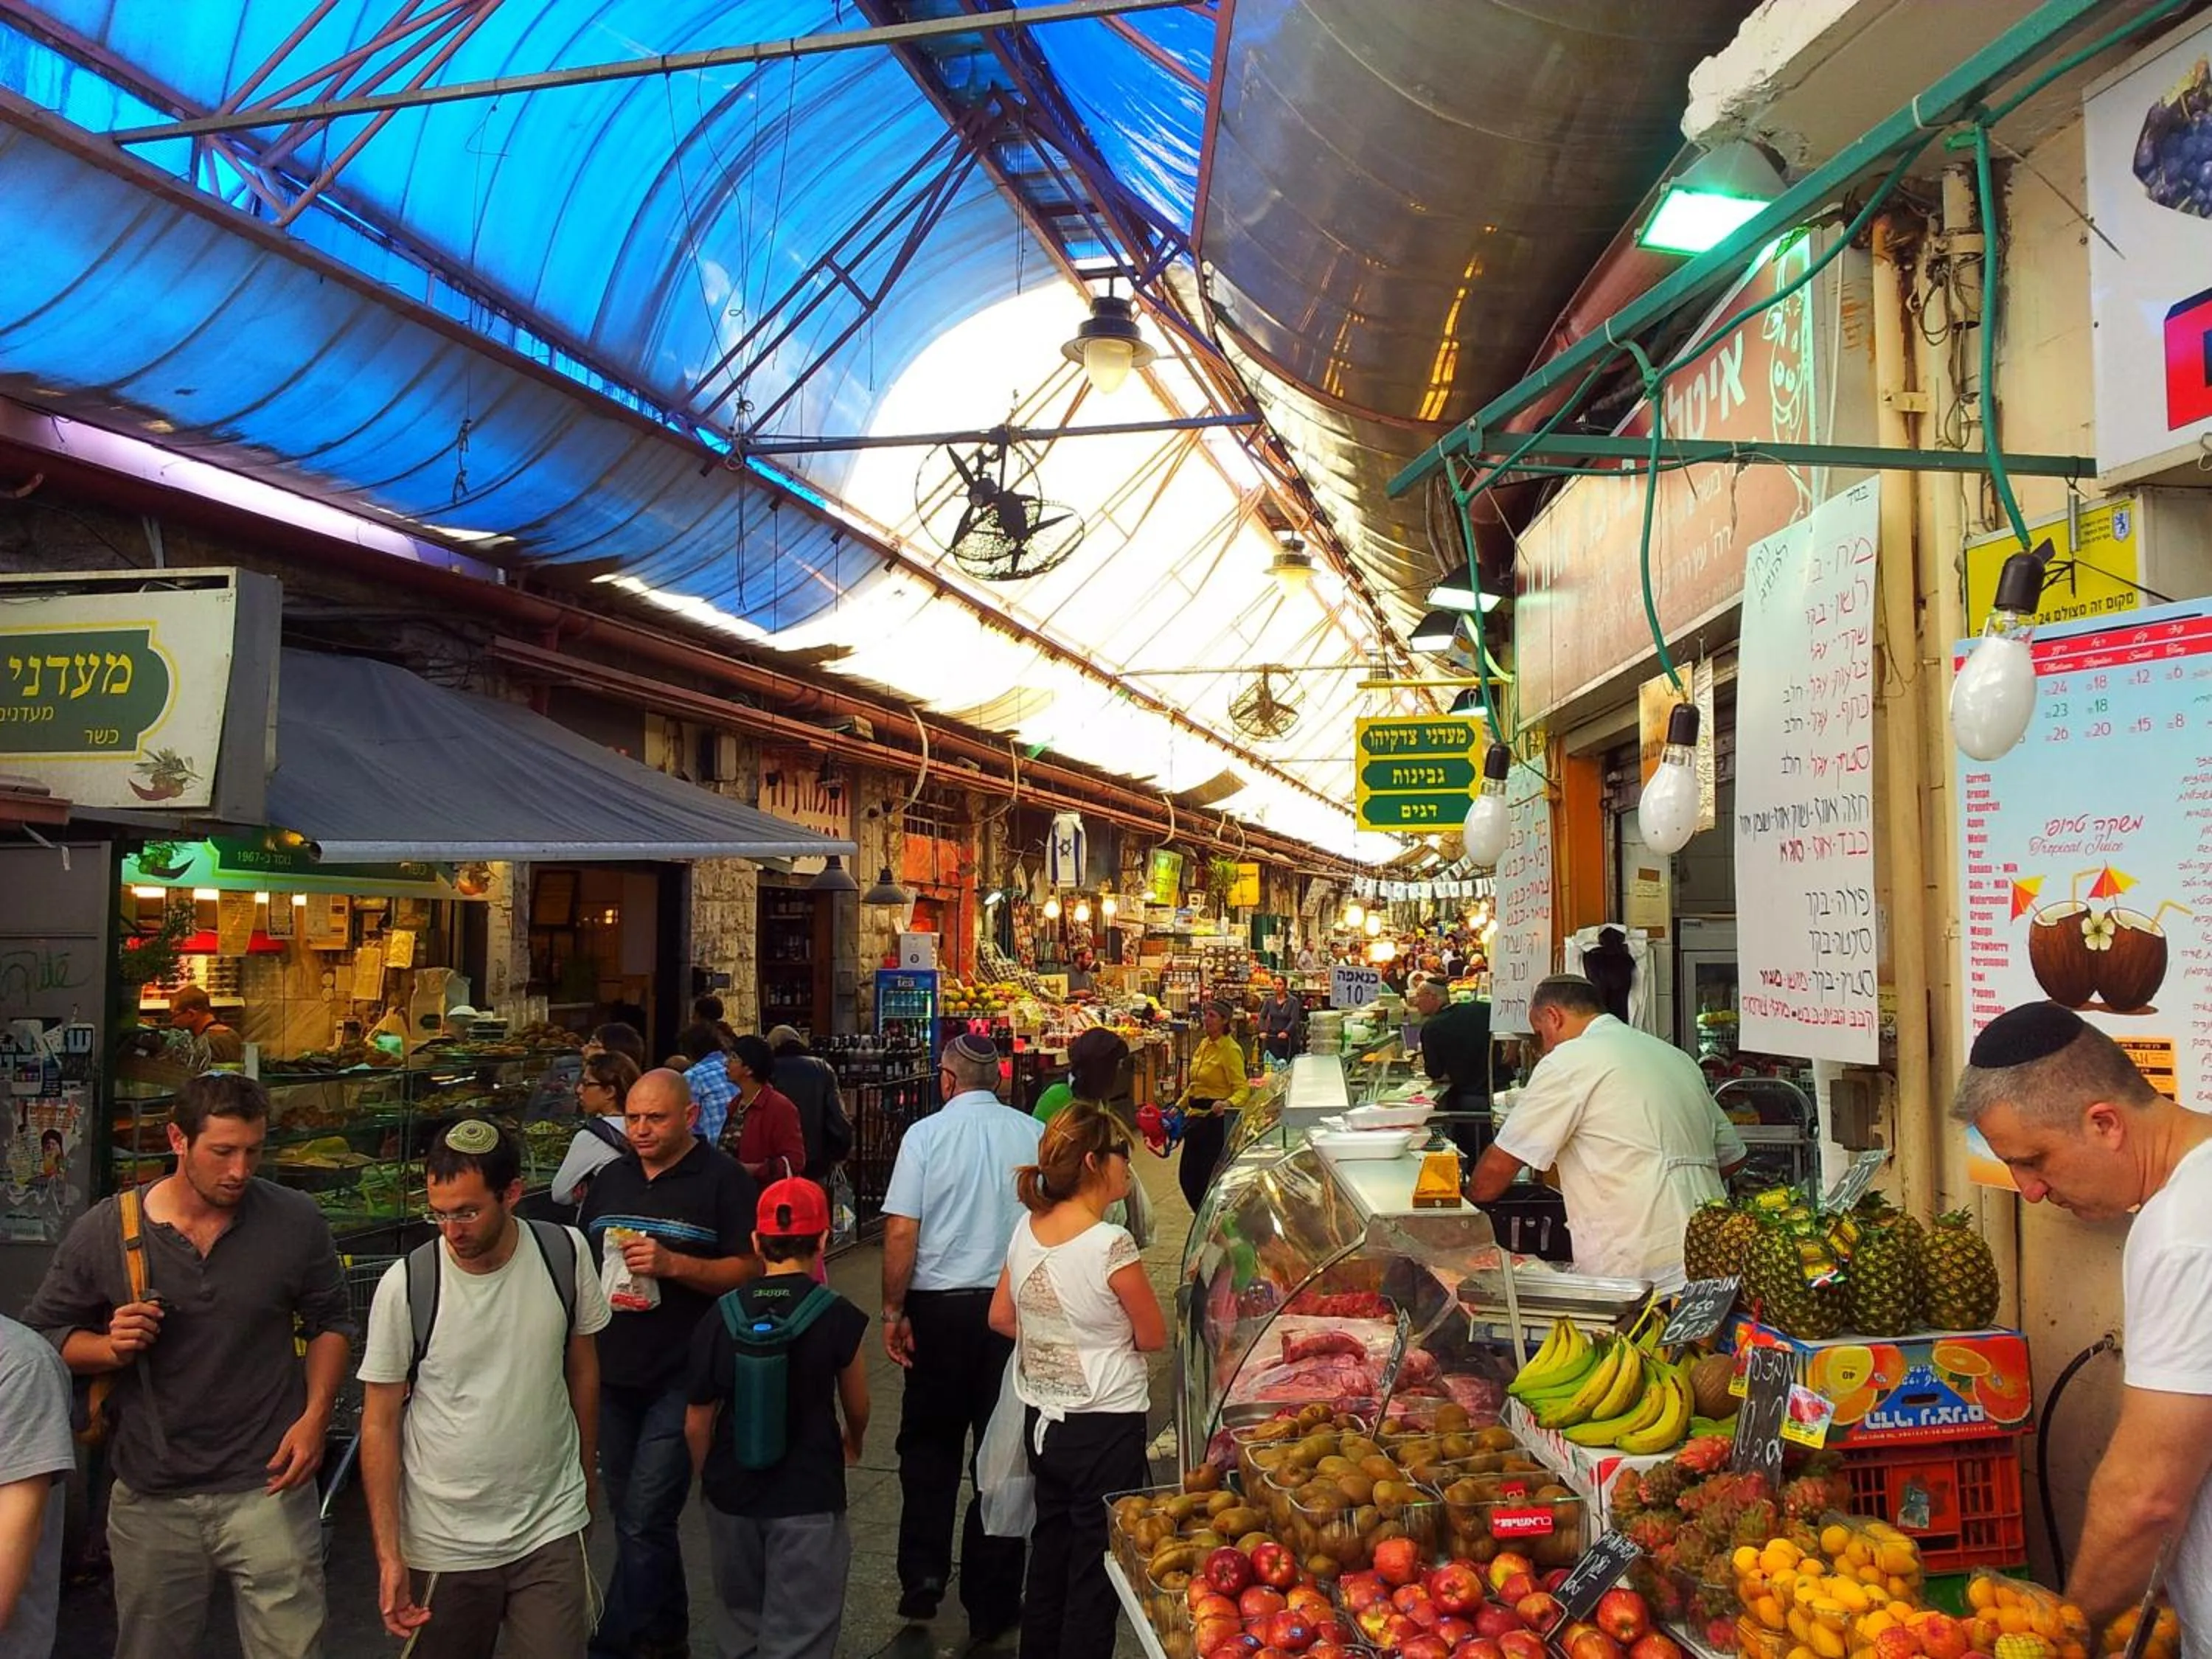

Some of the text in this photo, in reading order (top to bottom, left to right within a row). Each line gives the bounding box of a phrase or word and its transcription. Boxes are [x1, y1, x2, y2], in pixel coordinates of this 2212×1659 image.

[2090, 600, 2104, 614] זה
[2106, 591, 2135, 611] מקום
[2053, 602, 2087, 623] מצולם
[8, 651, 133, 700] מעדני
[84, 728, 119, 745] כשר
[1368, 727, 1467, 753] מעדני צדקיהו
[1392, 768, 1446, 785] גבינות
[1400, 804, 1438, 820] דגים
[2045, 813, 2144, 841] משקה טרופי
[2084, 834, 2124, 856] Juice
[1970, 941, 2008, 952] Strawberry
[1337, 970, 1379, 984] כנאפה
[1971, 972, 1986, 982] Kiwi
[1346, 984, 1363, 1005] 10
[1864, 1404, 1986, 1430] הדרי ניצנים
